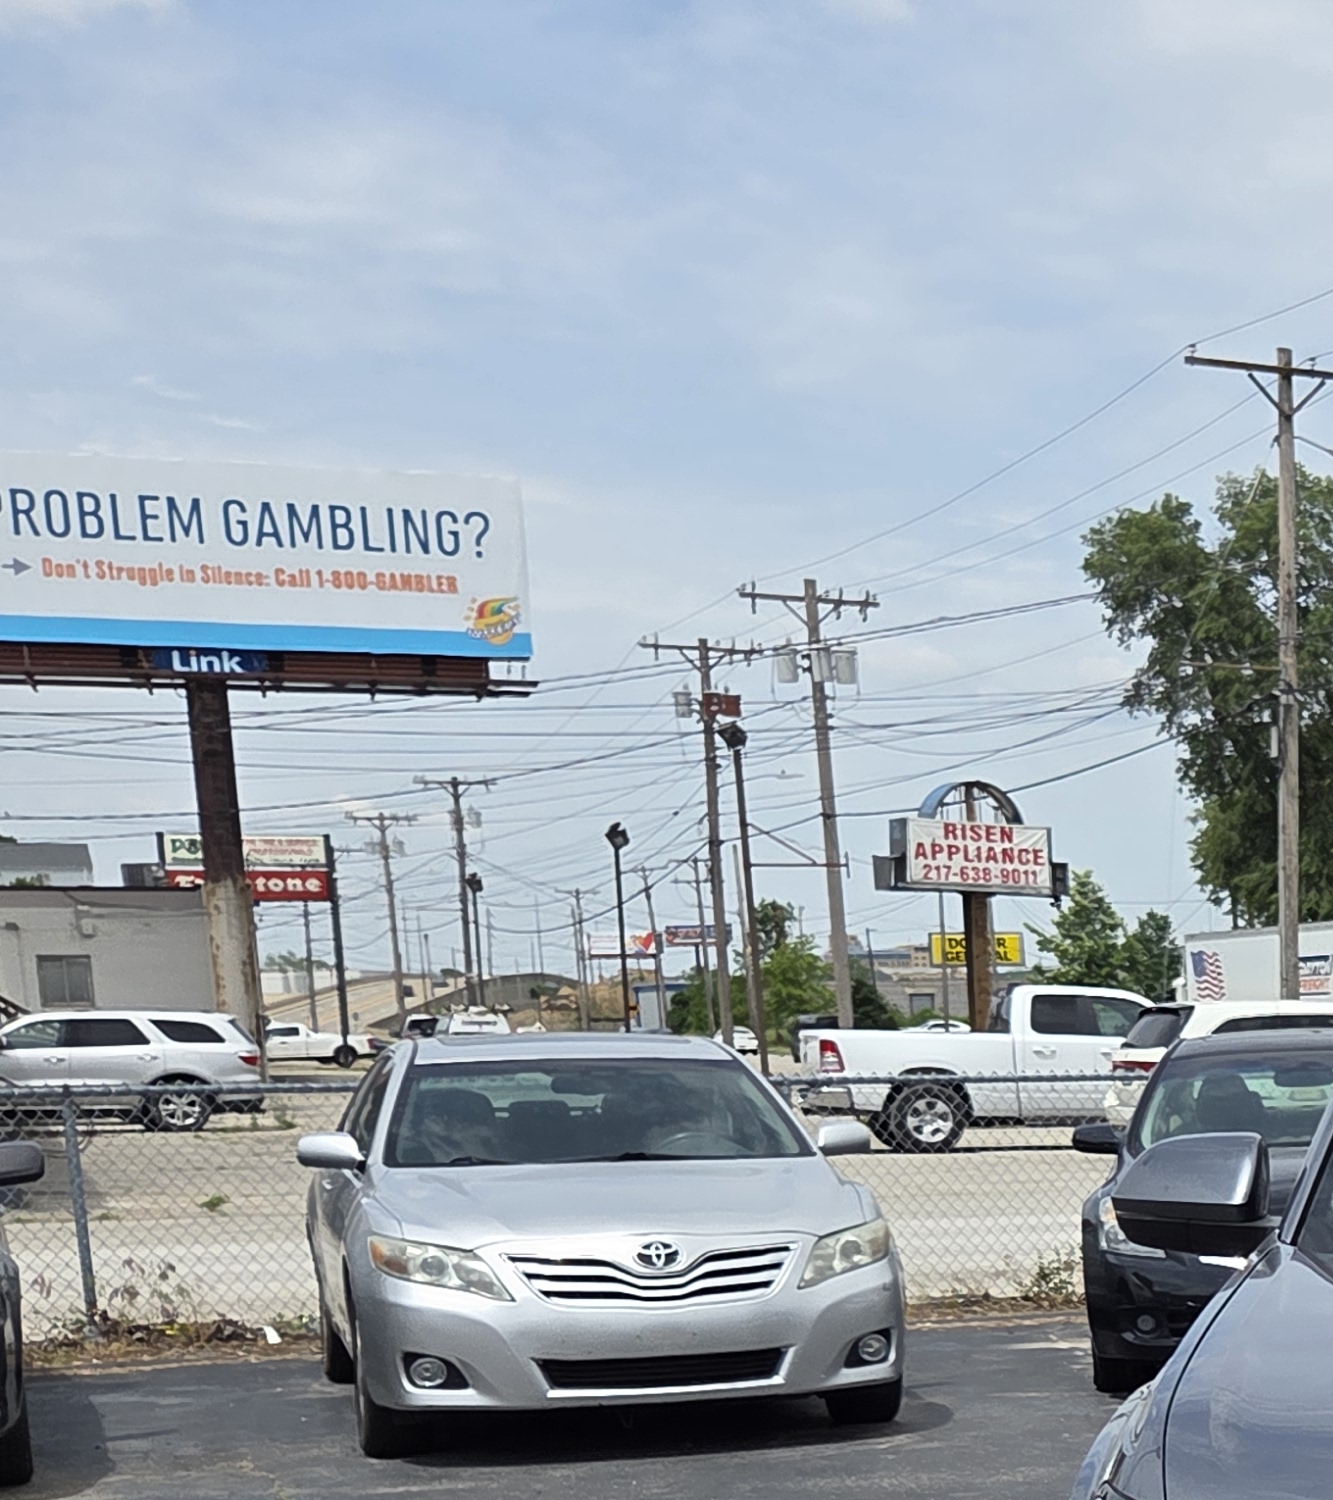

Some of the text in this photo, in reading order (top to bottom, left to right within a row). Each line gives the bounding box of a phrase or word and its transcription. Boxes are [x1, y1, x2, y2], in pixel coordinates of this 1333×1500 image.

[0, 487, 490, 558] ROBLEM GAMBLING?
[41, 557, 91, 580] Don't
[95, 559, 175, 587] Struggle
[274, 567, 312, 589] Call
[315, 568, 459, 595] 1-800-GAMBLER
[171, 650, 245, 673] Link
[943, 822, 1014, 844] RISEN
[914, 842, 1046, 867] APPLIANCE
[922, 863, 1038, 885] 217-638-9011
